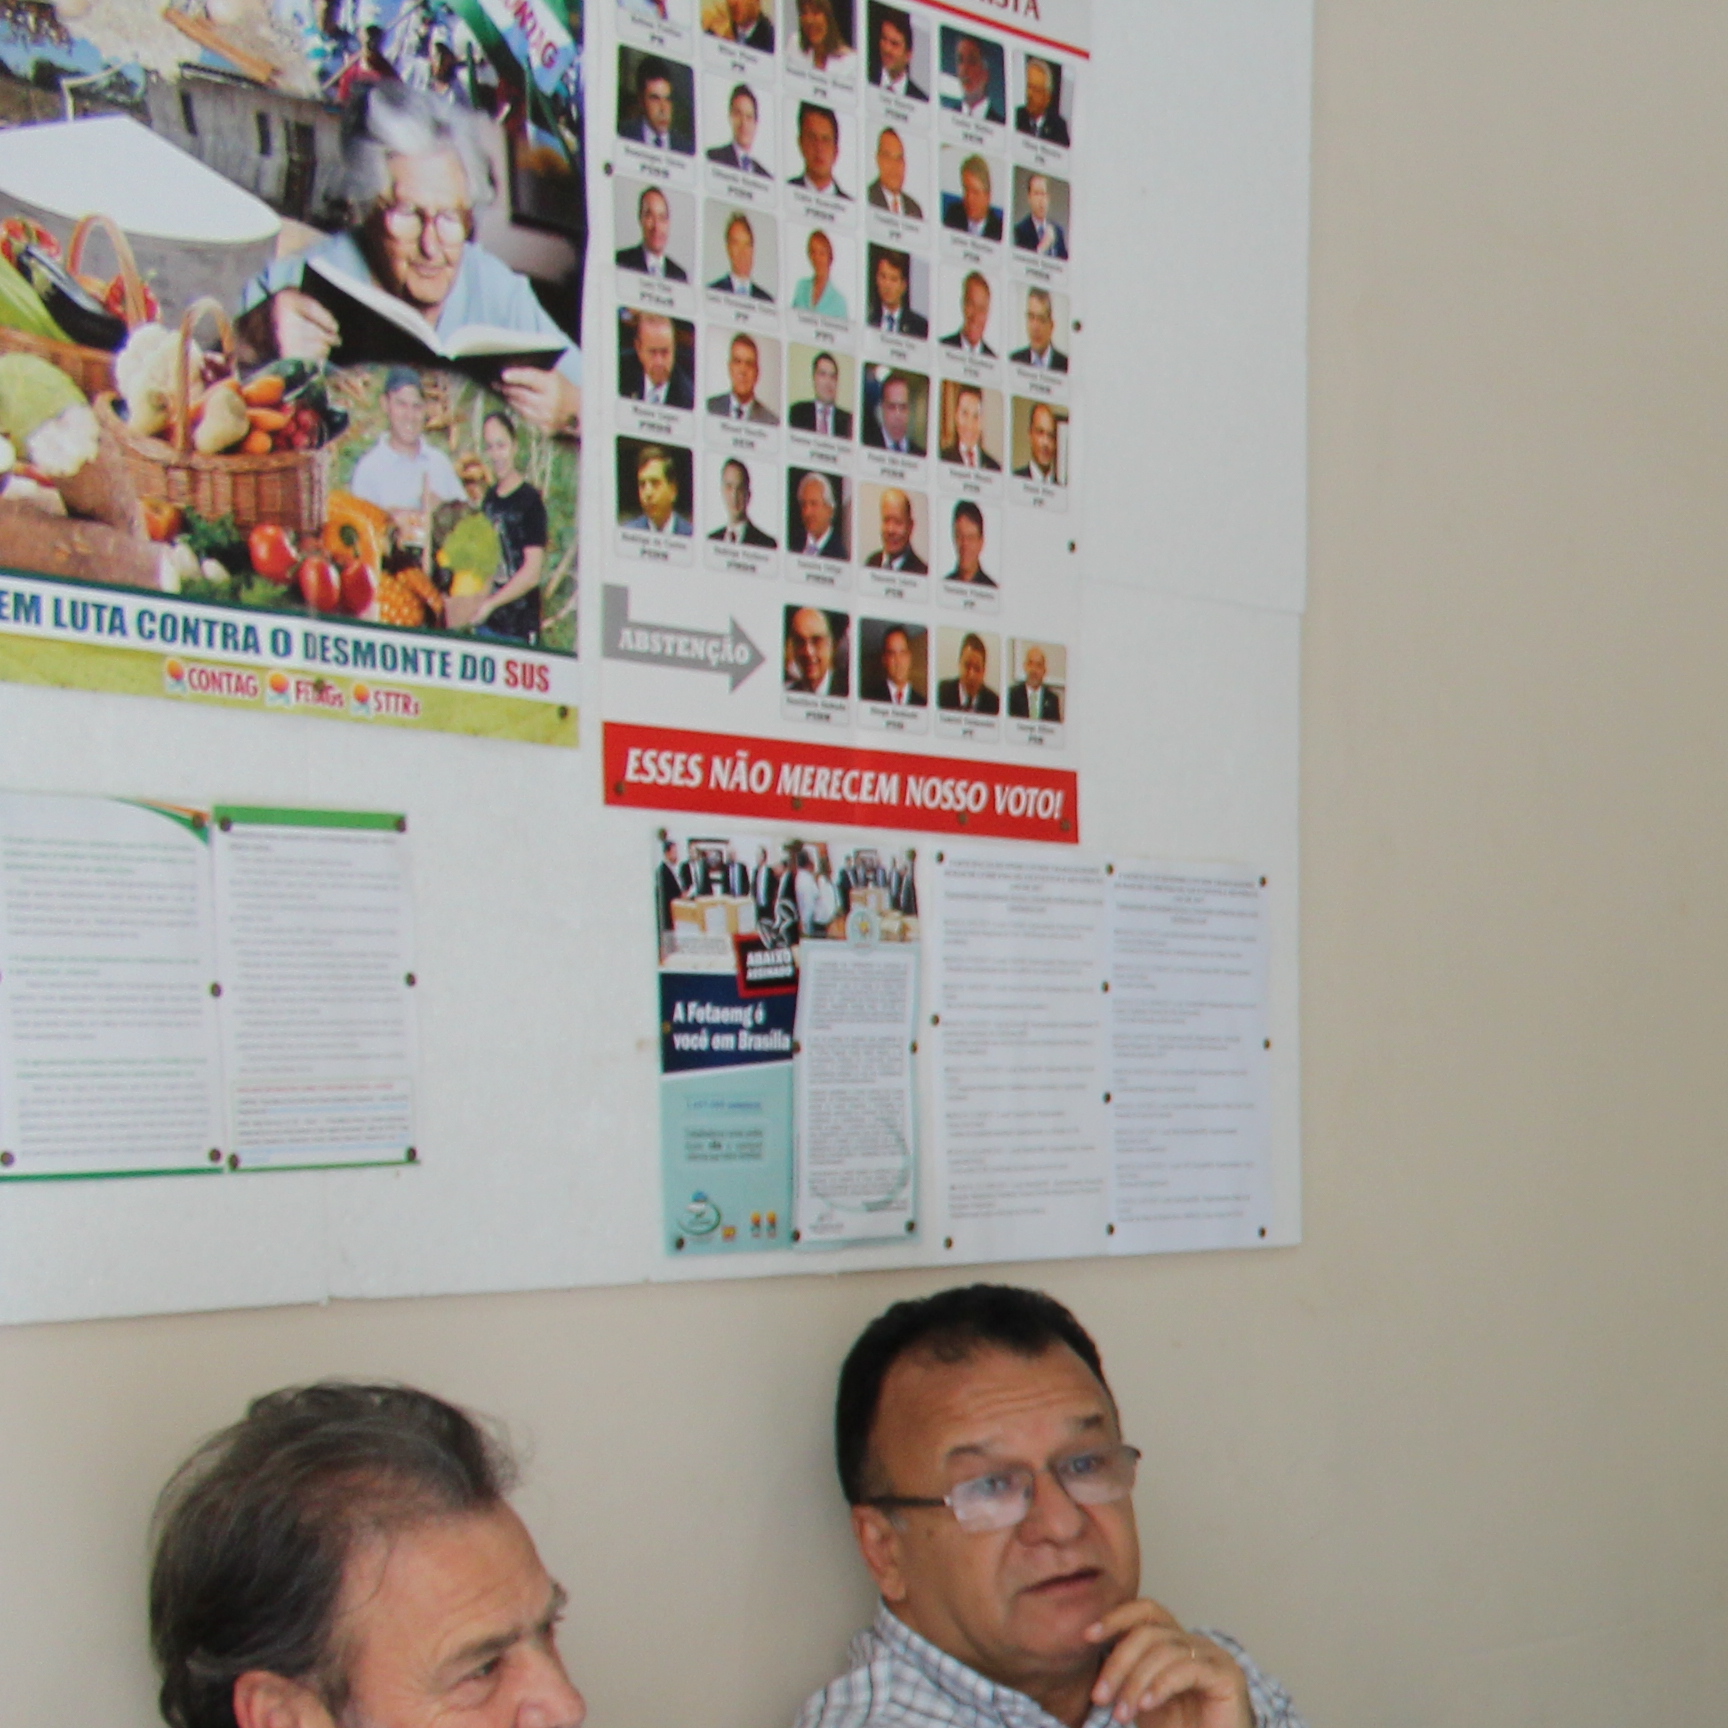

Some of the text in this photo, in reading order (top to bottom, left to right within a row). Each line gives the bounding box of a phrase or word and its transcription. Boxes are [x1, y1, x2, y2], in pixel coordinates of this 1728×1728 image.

[0, 589, 550, 694] EM LUTA CONTRA O DESMONTE DO SUS
[618, 627, 750, 667] ABSTENÇÃO
[187, 667, 259, 698] CONTAG
[625, 747, 1063, 820] ESSES NÃO MERECEM NOSSO VOTO!
[673, 1002, 686, 1023] A
[673, 1030, 708, 1050] você
[711, 1034, 734, 1050] em
